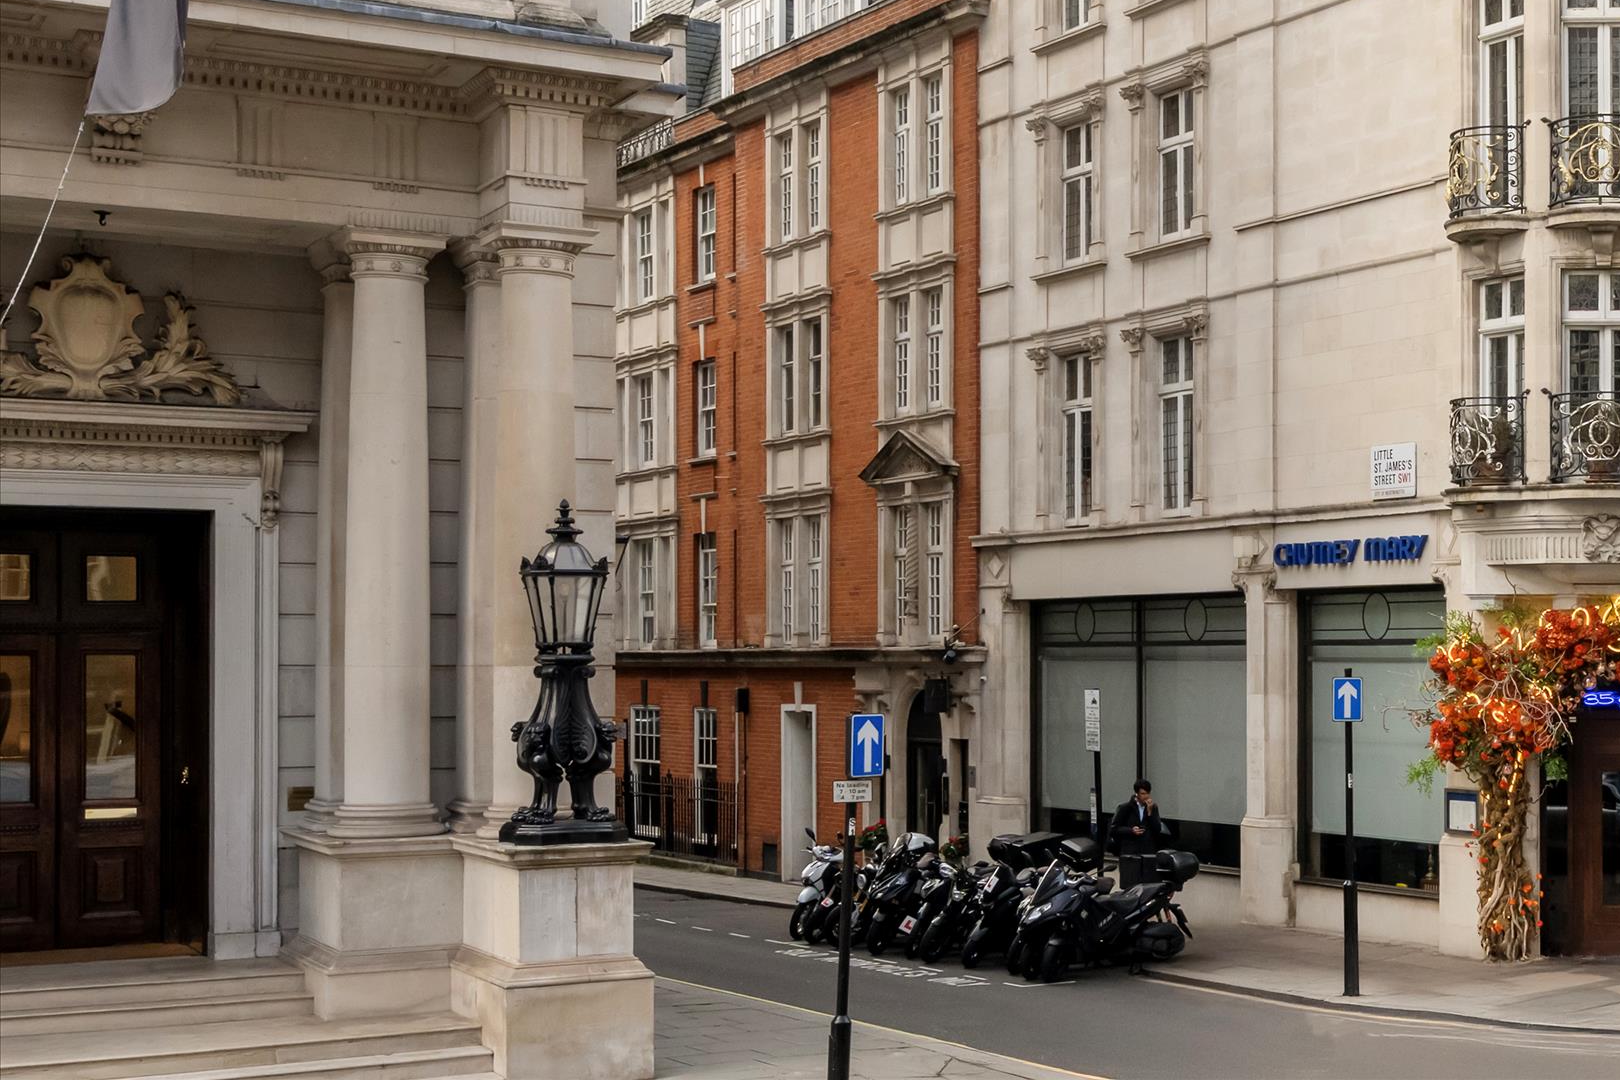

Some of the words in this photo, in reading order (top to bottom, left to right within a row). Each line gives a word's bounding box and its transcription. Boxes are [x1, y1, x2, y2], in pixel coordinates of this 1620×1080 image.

[1374, 449, 1393, 461] LITTLE
[1385, 459, 1412, 472] JAMES'S
[1374, 474, 1396, 485] STREET
[1398, 472, 1411, 484] SW1
[1273, 539, 1360, 567] CHUTNEY
[1364, 535, 1429, 562] MARY
[1583, 693, 1615, 706] 35
